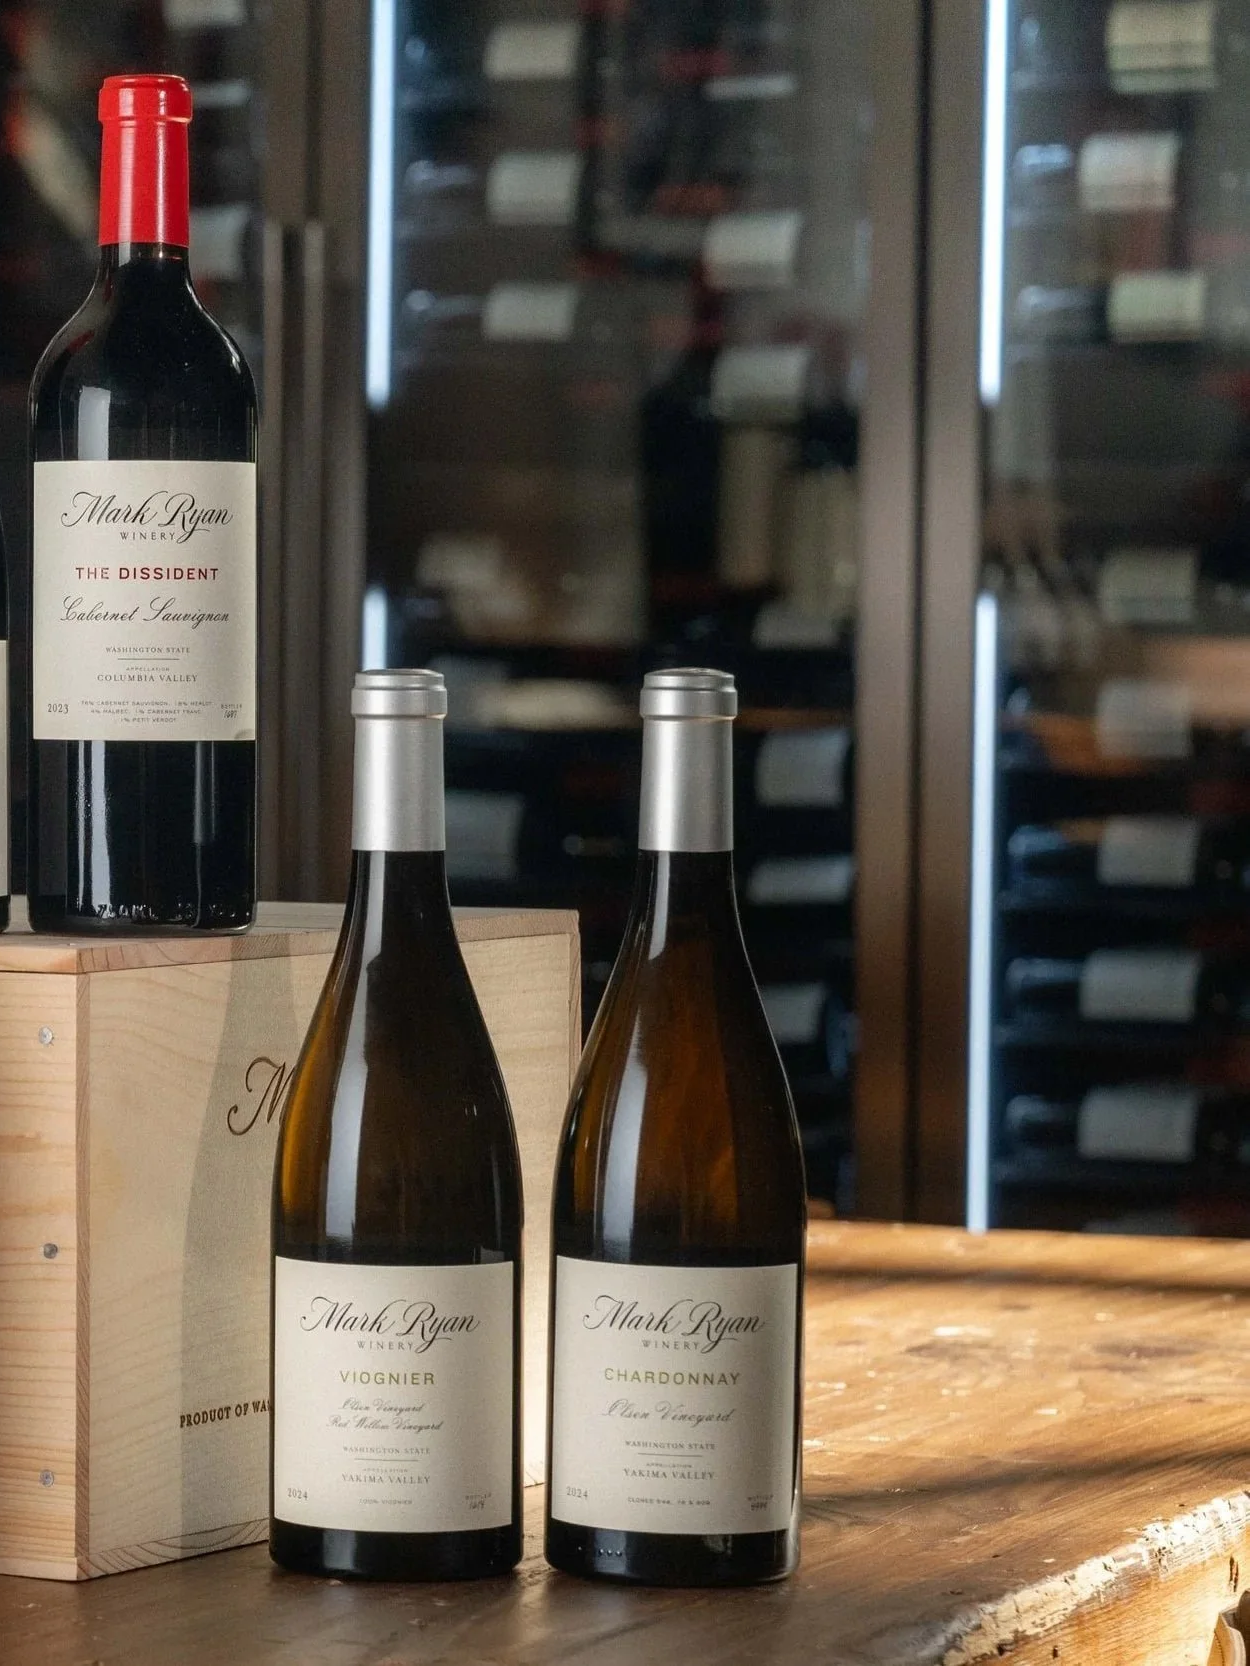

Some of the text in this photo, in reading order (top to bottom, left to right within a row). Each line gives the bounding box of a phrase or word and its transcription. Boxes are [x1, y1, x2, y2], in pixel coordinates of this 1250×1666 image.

[61, 491, 234, 544] Mark Ryan
[120, 532, 176, 541] WINERY
[75, 567, 219, 580] THE DISSIDENT
[60, 596, 229, 629] Cabernet Sauvignon
[97, 674, 197, 682] COLUMBIA VALLEY
[47, 703, 69, 714] 2023
[300, 1296, 479, 1353] Mark Ryan
[583, 1295, 765, 1353] Mark Ryan
[357, 1341, 415, 1350] WINERY
[642, 1340, 700, 1350] WINERY
[340, 1371, 435, 1385] VIOGNIER
[604, 1368, 741, 1385] CHARDONNAY
[180, 1406, 231, 1428] PRODUCT
[234, 1402, 249, 1418] OF
[602, 1398, 734, 1428] Olsen Vineyard
[343, 1446, 400, 1454] WASHINGTON
[626, 1441, 686, 1449] WASHINGTON
[342, 1473, 431, 1484] YAKIMA VALLEY
[623, 1468, 715, 1480] YAKIMA VALLEY
[287, 1489, 308, 1500] 2024
[566, 1487, 588, 1498] 2024
